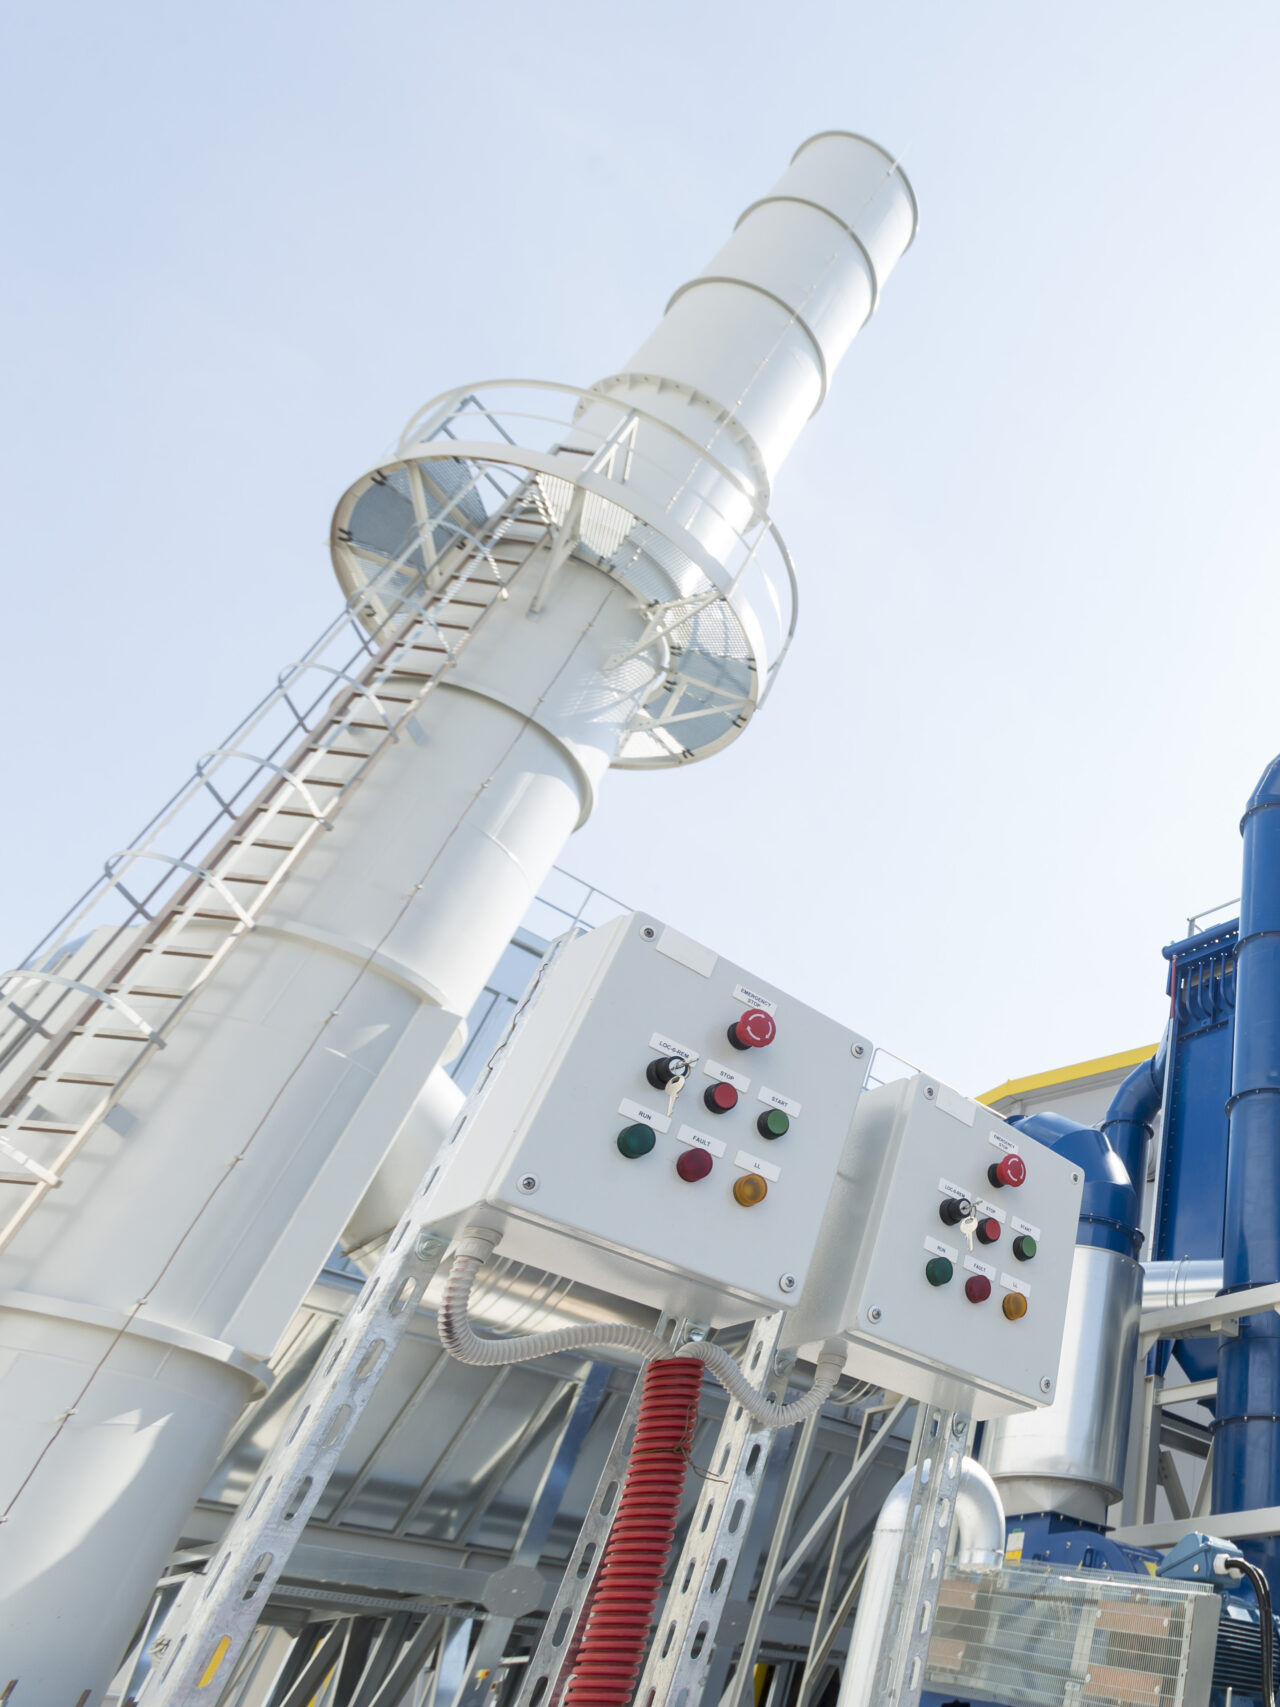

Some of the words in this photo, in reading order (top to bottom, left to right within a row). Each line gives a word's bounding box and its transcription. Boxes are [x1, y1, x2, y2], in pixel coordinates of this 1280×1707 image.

[740, 987, 771, 1007] EMERGENCY
[747, 998, 761, 1008] STOP
[720, 1070, 735, 1081] STOP
[771, 1096, 789, 1108] START
[638, 1110, 652, 1121] RUN
[692, 1135, 711, 1147] FAULT
[973, 1263, 987, 1273] FAULT
